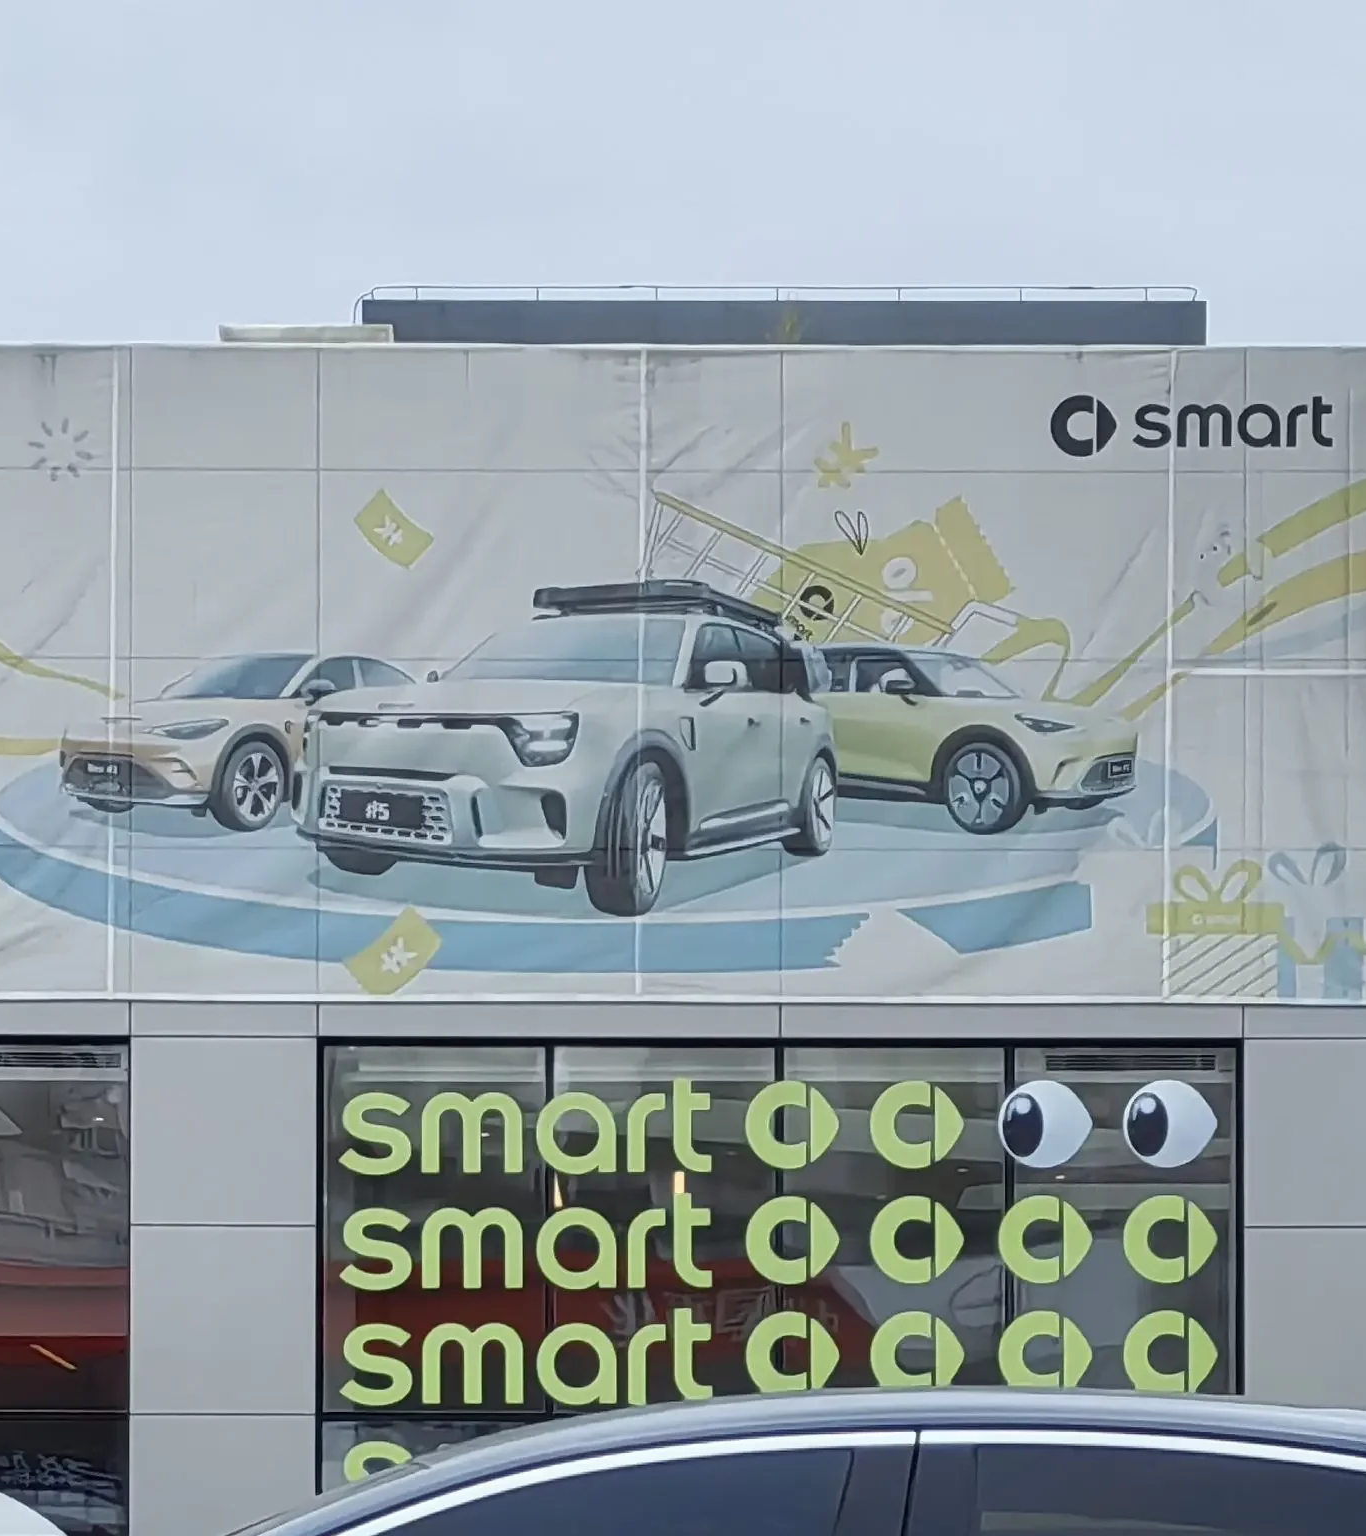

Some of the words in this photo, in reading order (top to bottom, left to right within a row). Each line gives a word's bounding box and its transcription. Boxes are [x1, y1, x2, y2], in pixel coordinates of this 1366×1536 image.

[1132, 395, 1333, 448] smart
[338, 1077, 713, 1176] smart
[338, 1192, 713, 1291] smart
[338, 1307, 713, 1407] smart
